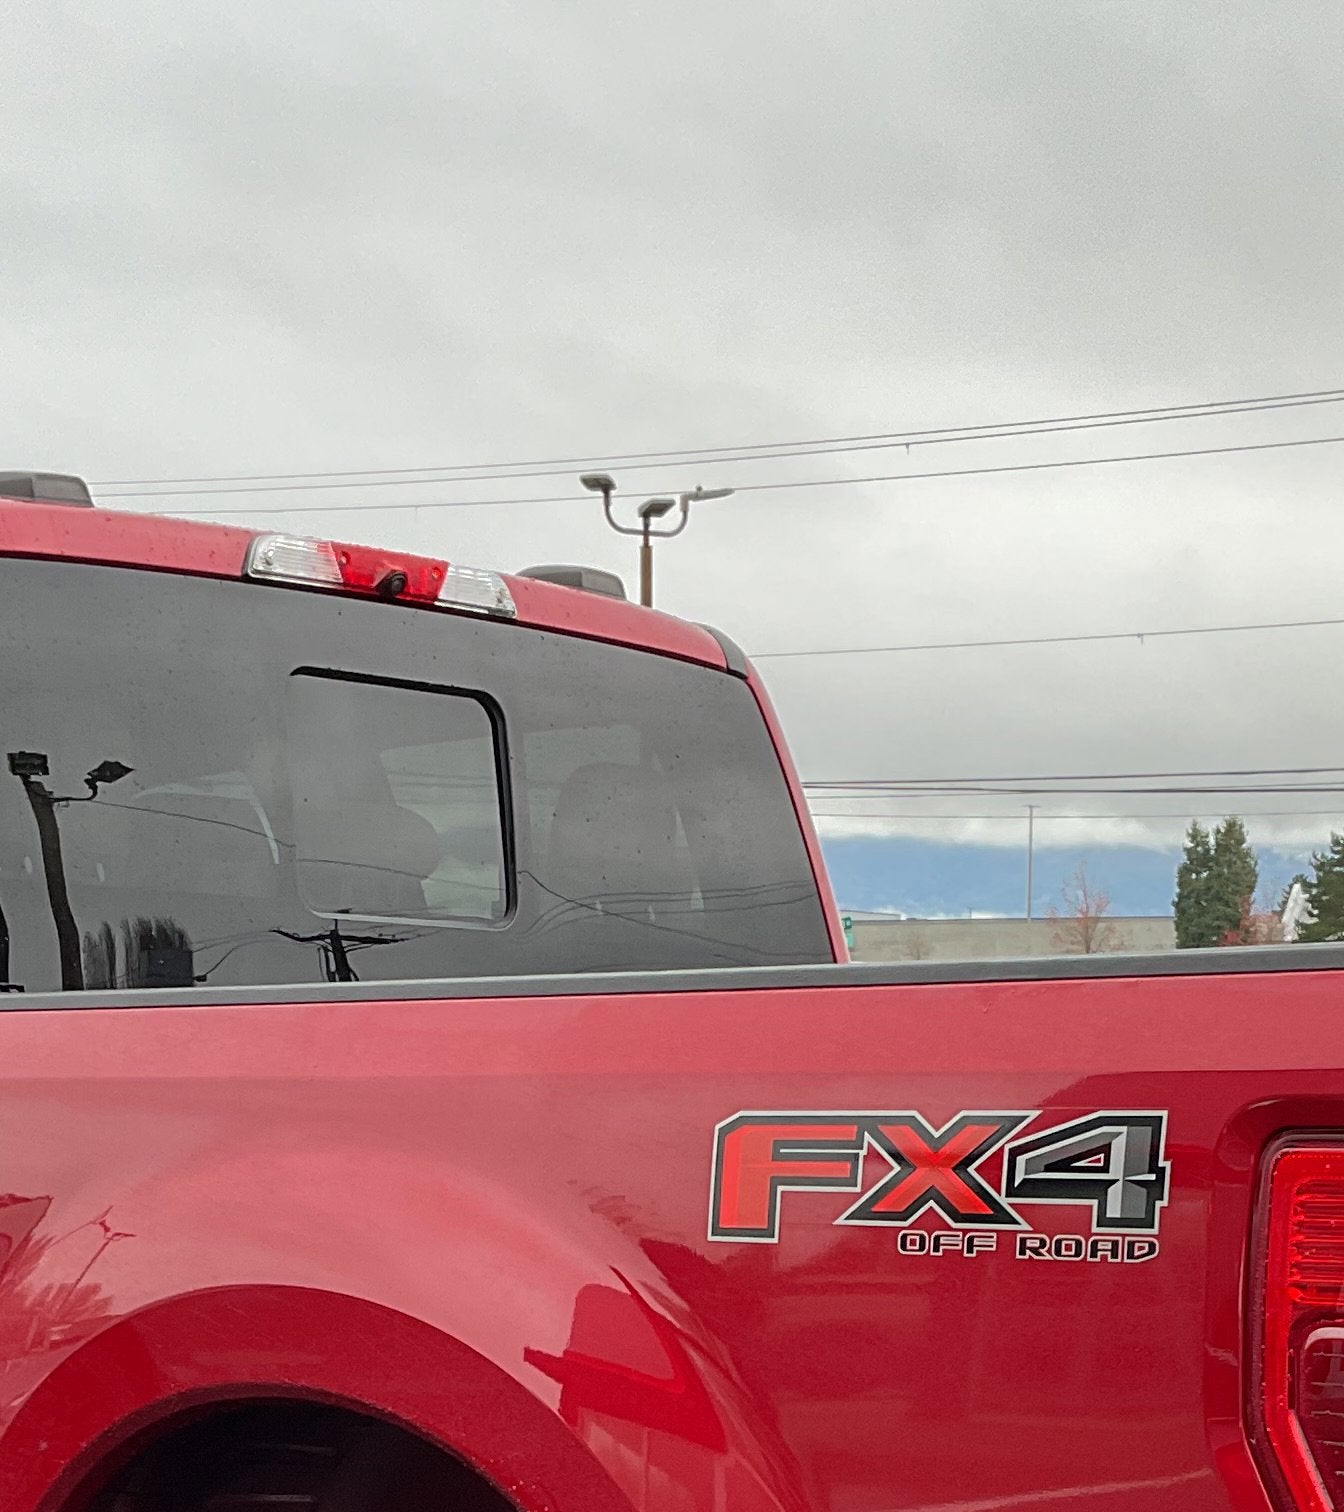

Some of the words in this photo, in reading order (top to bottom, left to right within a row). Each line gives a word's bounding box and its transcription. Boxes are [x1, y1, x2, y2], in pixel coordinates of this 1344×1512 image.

[707, 1110, 1171, 1243] FX4
[897, 1230, 997, 1257] OFF
[1016, 1234, 1160, 1263] ROAD
